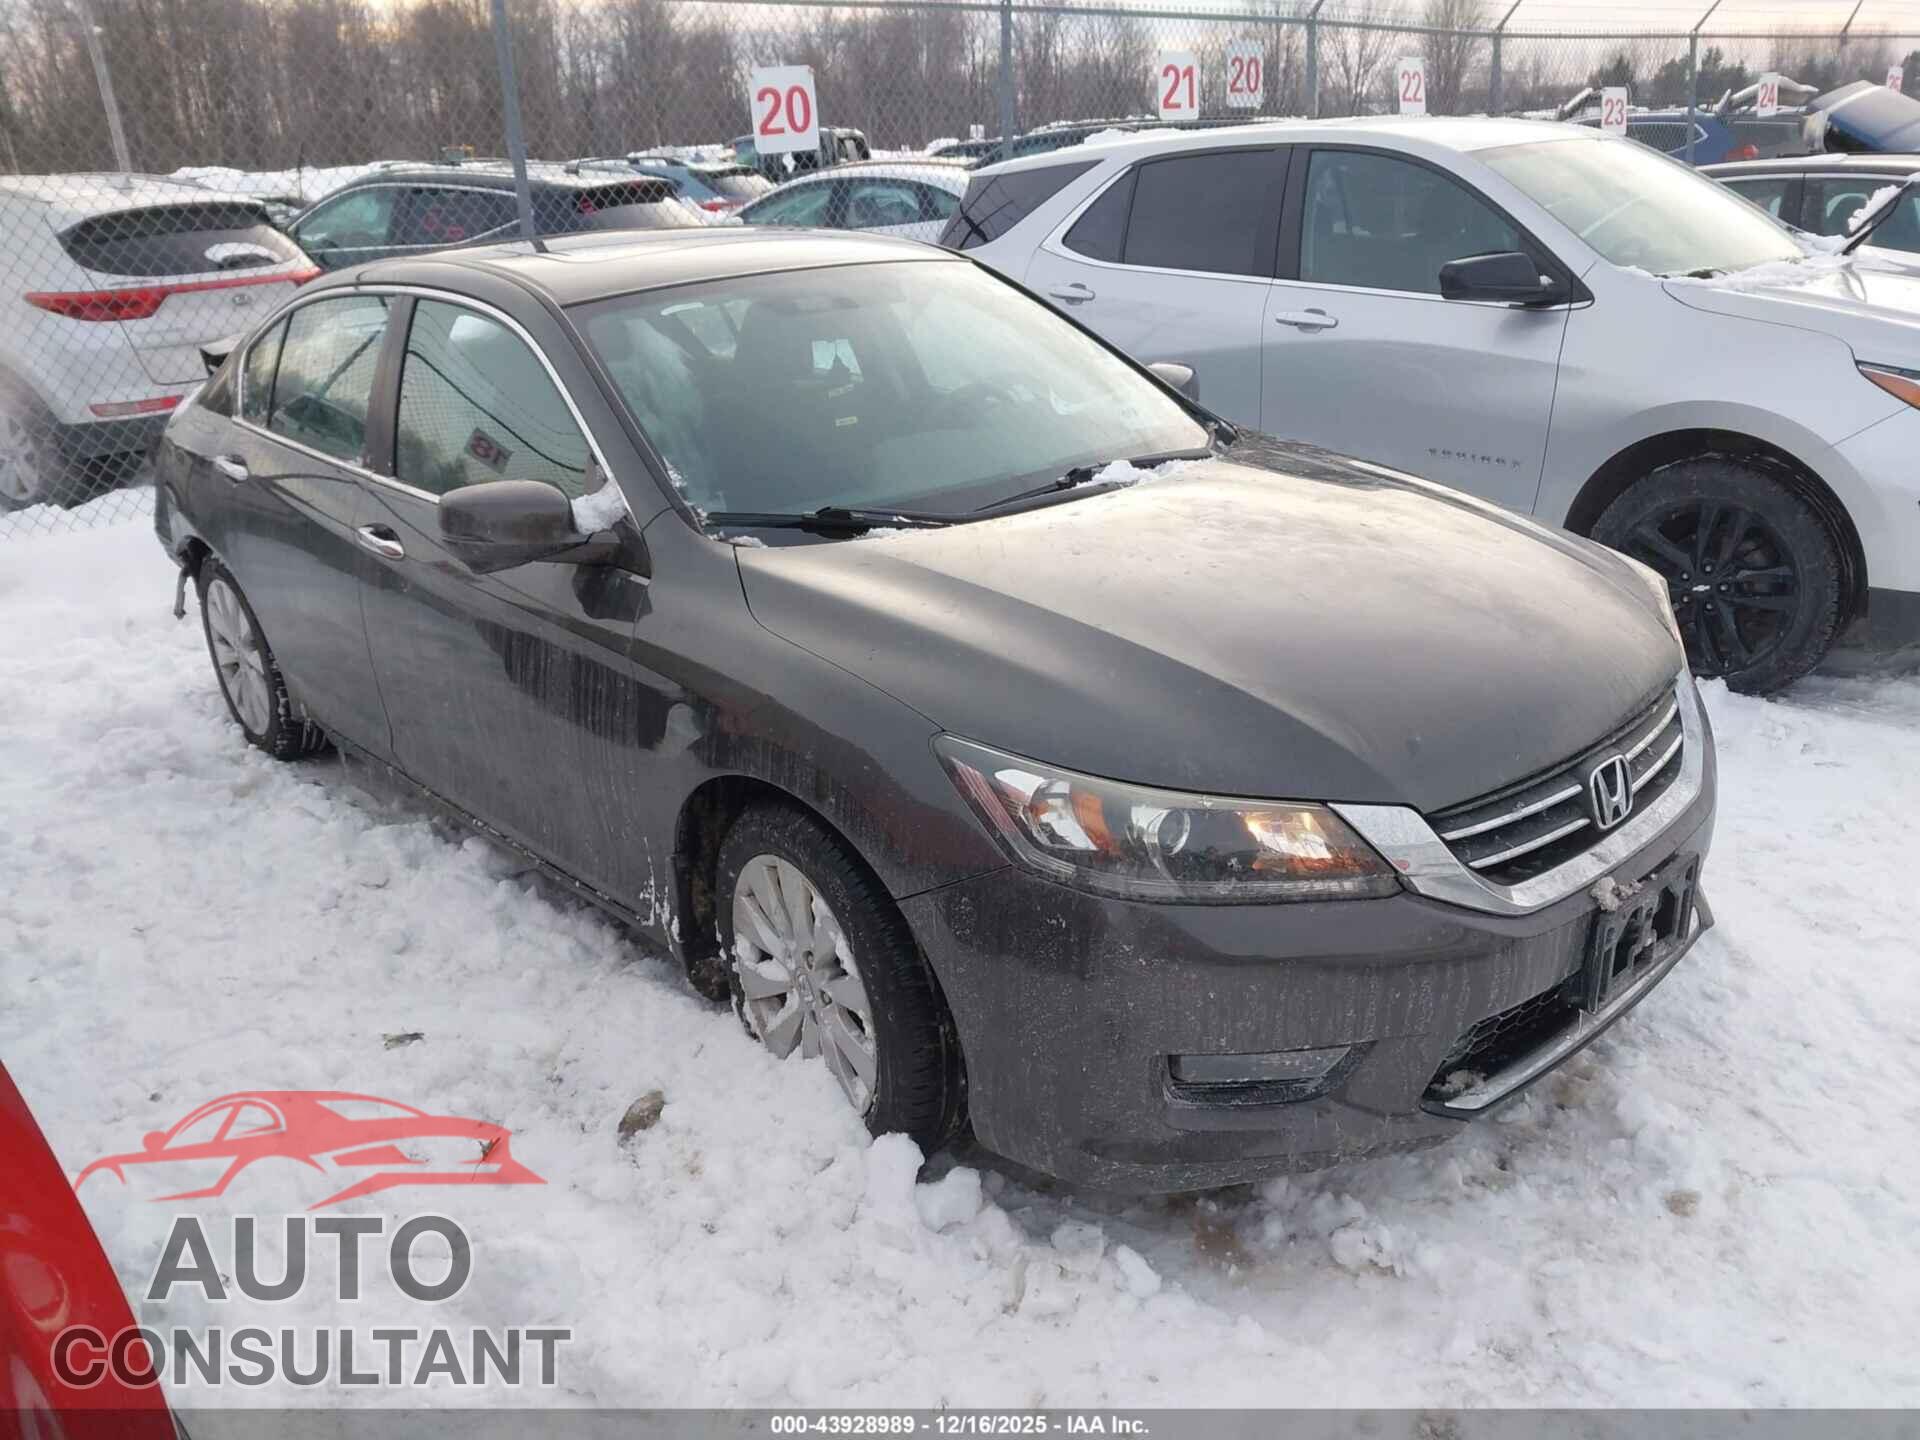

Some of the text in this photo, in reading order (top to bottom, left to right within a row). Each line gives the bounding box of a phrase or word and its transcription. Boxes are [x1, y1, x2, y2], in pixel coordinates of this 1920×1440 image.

[1162, 64, 1194, 109] 21
[1231, 56, 1260, 93] 20
[1401, 70, 1423, 102] 22
[757, 86, 810, 136] 20
[1604, 98, 1624, 125] 23
[1760, 83, 1776, 108] 24
